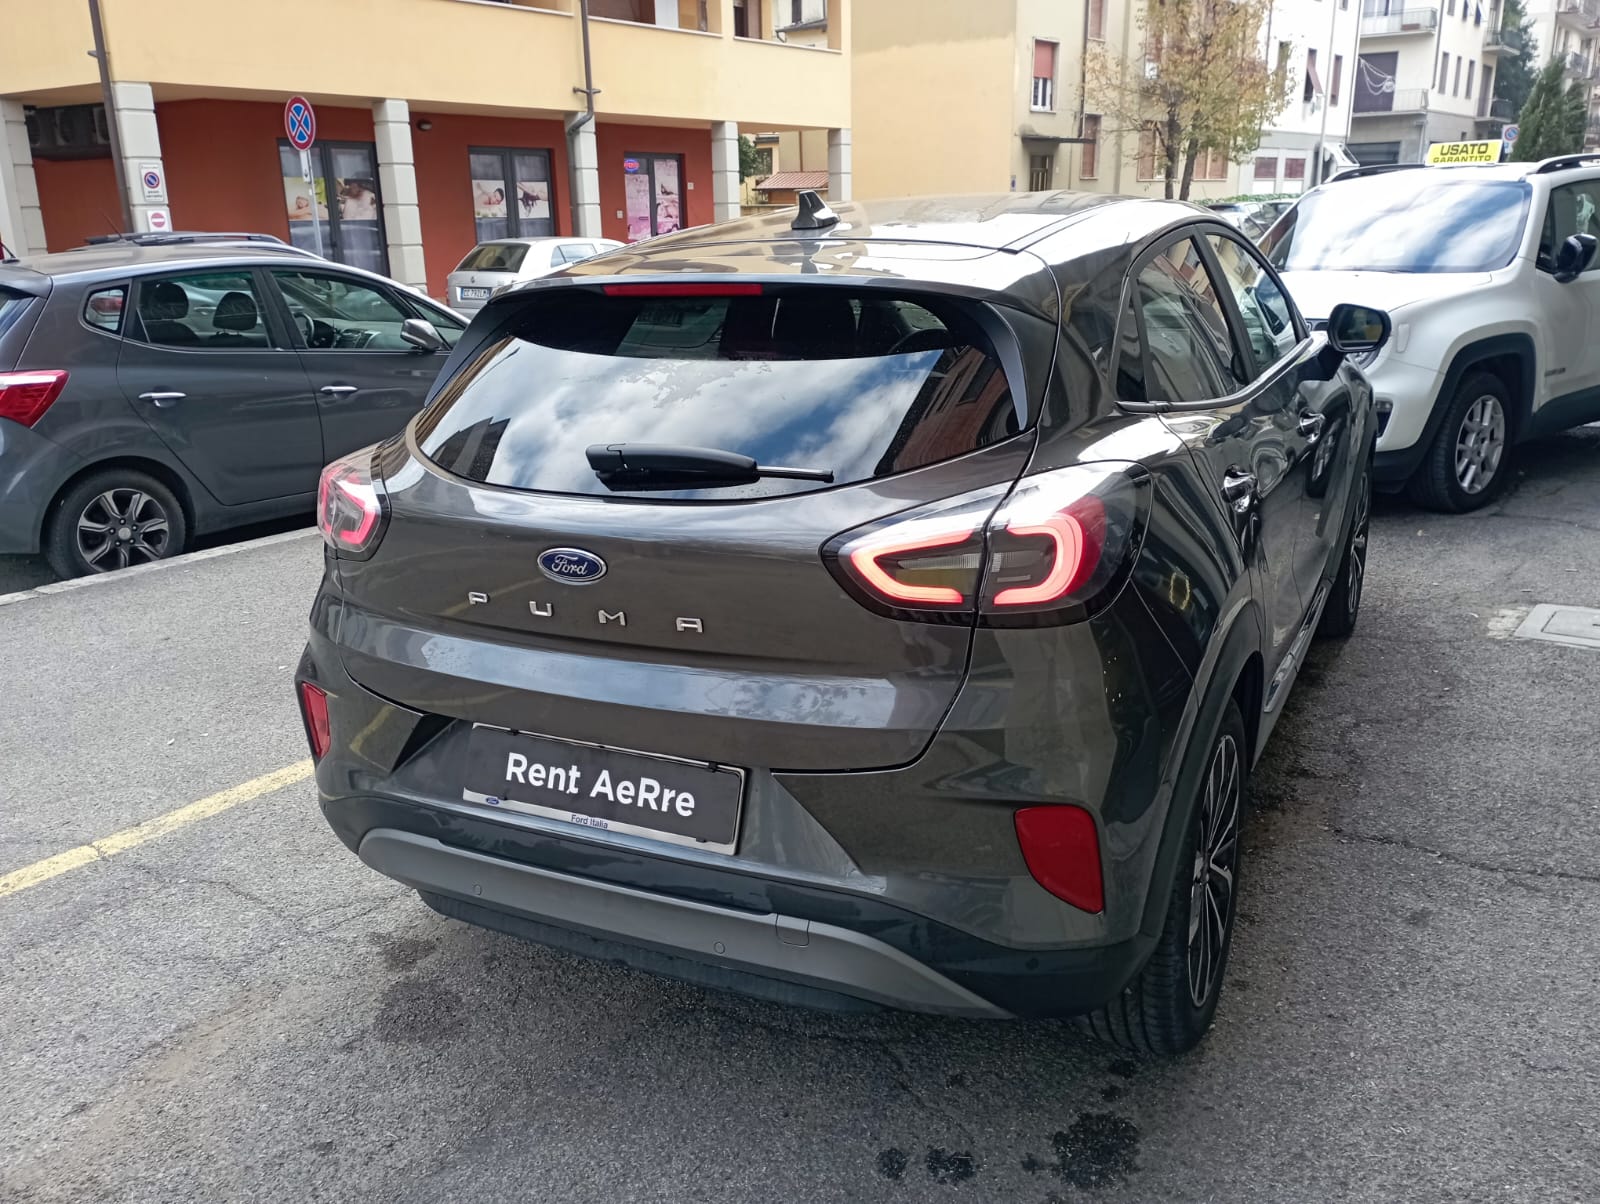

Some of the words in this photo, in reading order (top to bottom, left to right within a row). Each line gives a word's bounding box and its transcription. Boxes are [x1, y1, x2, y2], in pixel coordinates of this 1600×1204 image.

[1440, 143, 1489, 156] USATO
[1433, 155, 1492, 163] GARANTITO
[551, 554, 588, 575] Ford
[468, 591, 703, 633] PUMA
[505, 752, 581, 795] Rent
[590, 769, 695, 817] AeRre
[571, 814, 588, 825] Ford
[590, 817, 608, 829] Italia
